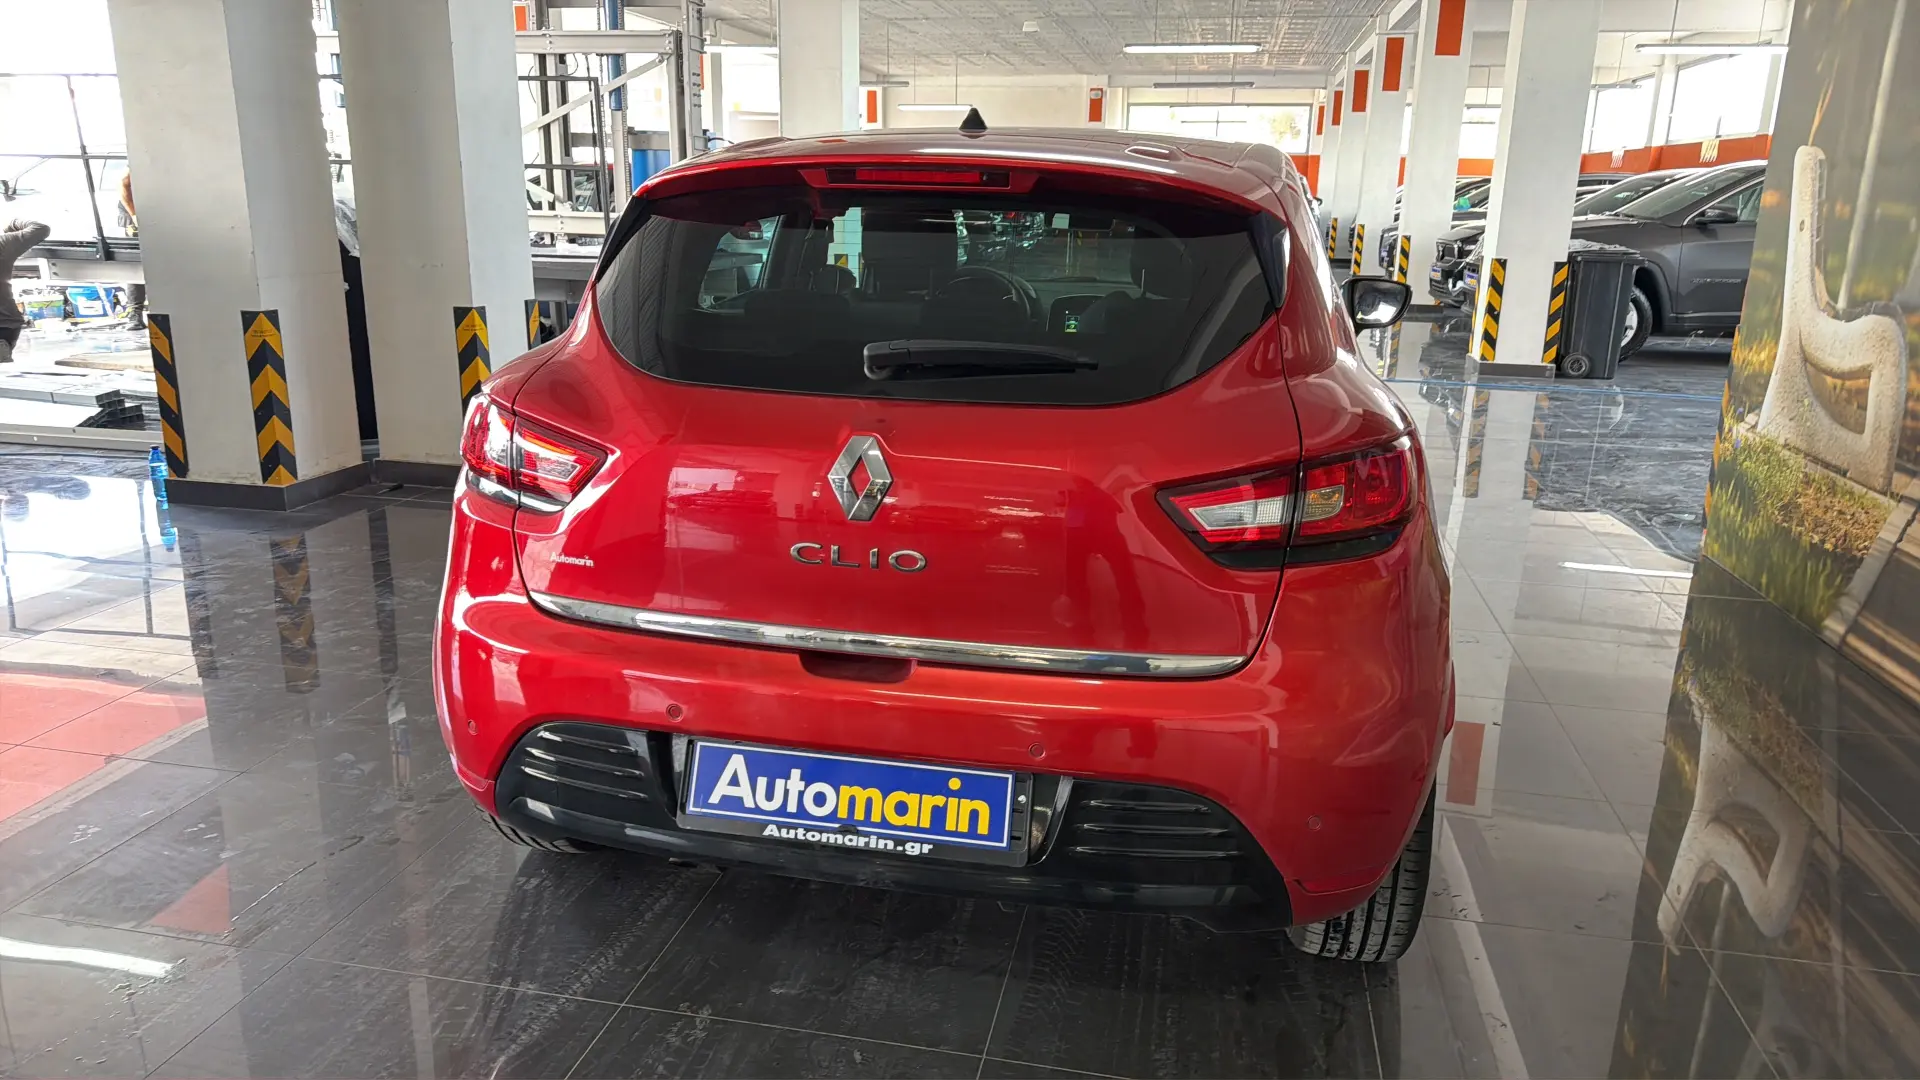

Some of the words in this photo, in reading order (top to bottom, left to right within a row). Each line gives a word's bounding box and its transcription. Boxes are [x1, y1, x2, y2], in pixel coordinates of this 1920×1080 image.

[550, 552, 595, 568] Automarin
[790, 542, 927, 572] CLIO
[708, 754, 990, 835] Automarin
[762, 824, 934, 856] Automarin.gr
